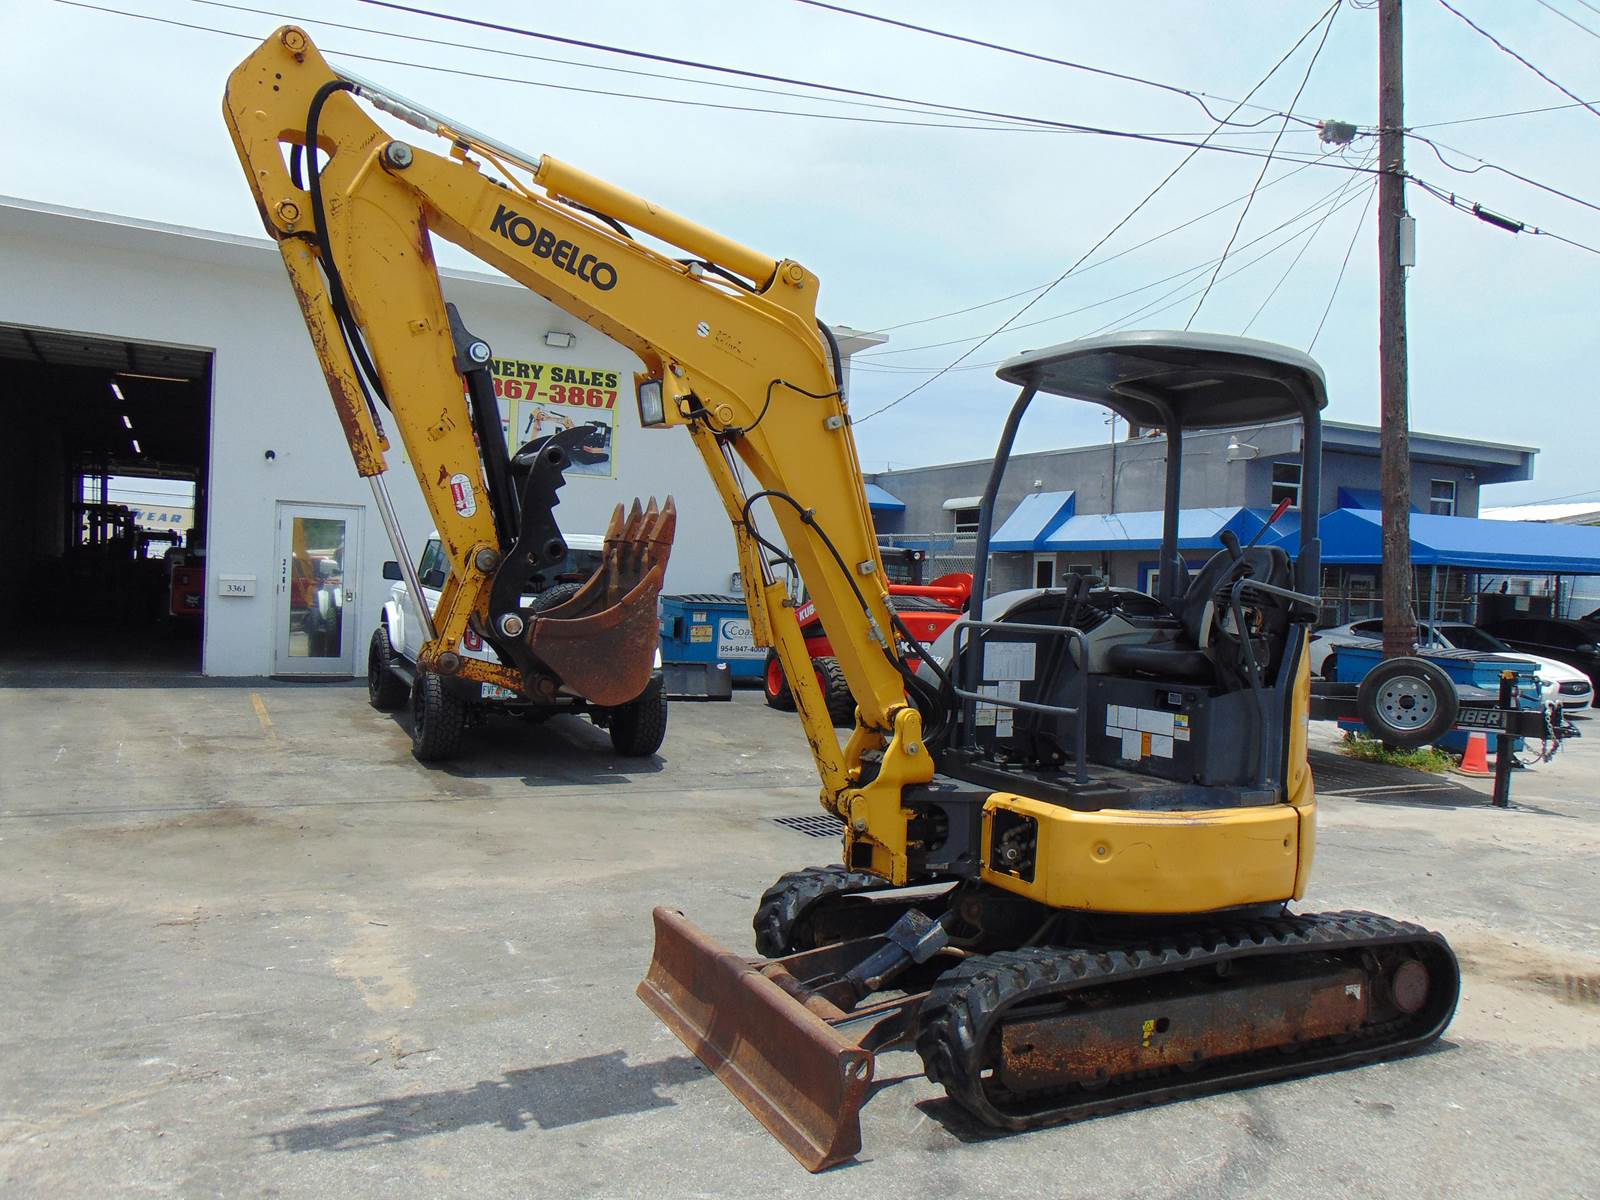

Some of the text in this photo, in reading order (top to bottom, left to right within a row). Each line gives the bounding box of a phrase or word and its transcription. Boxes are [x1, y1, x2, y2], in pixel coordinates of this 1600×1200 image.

[490, 204, 617, 290] KOBELCO
[490, 359, 617, 389] NERY SALES
[227, 584, 247, 593] 3361
[799, 603, 816, 622] KUB
